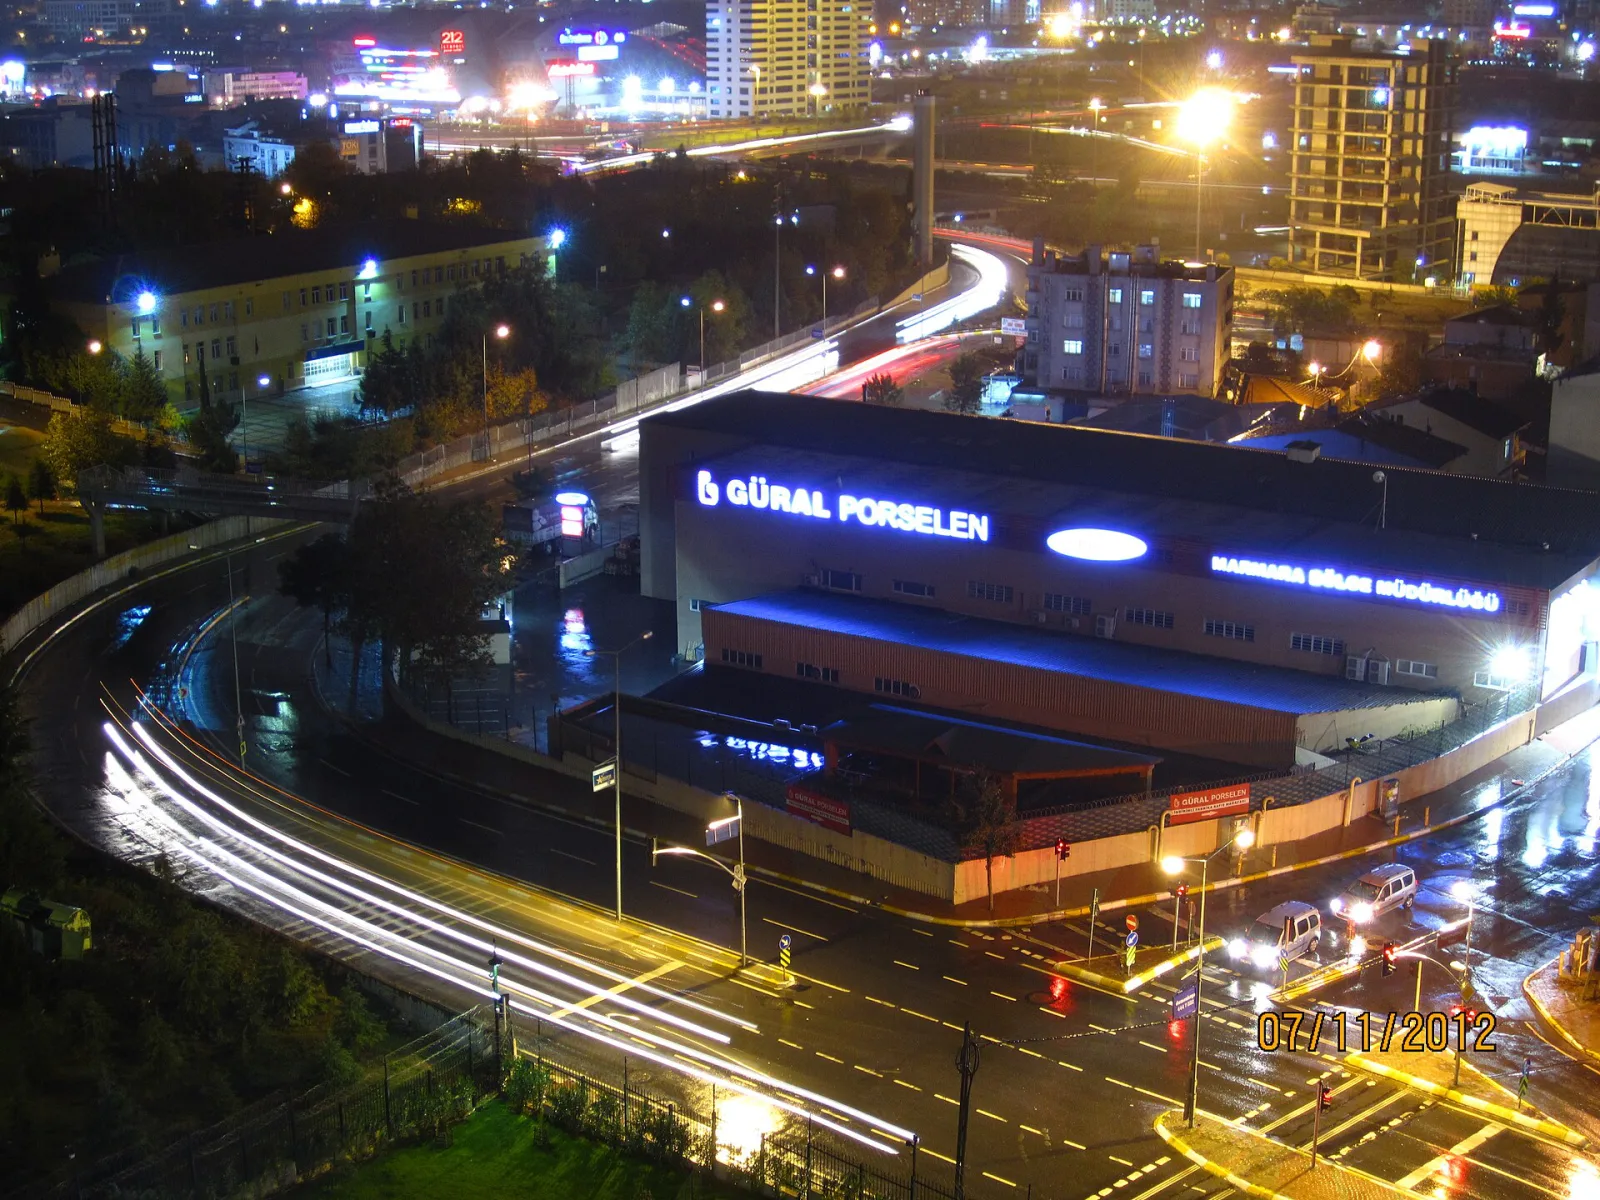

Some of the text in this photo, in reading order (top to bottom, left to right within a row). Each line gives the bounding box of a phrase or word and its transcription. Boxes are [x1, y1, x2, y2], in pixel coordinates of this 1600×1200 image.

[441, 31, 463, 43] 212
[726, 476, 989, 542] GÜRAL PORSELEN
[1211, 555, 1305, 585] MARMARA
[1308, 567, 1373, 594] BÖLGE
[1181, 789, 1247, 806] GÜRAL PORSELEN
